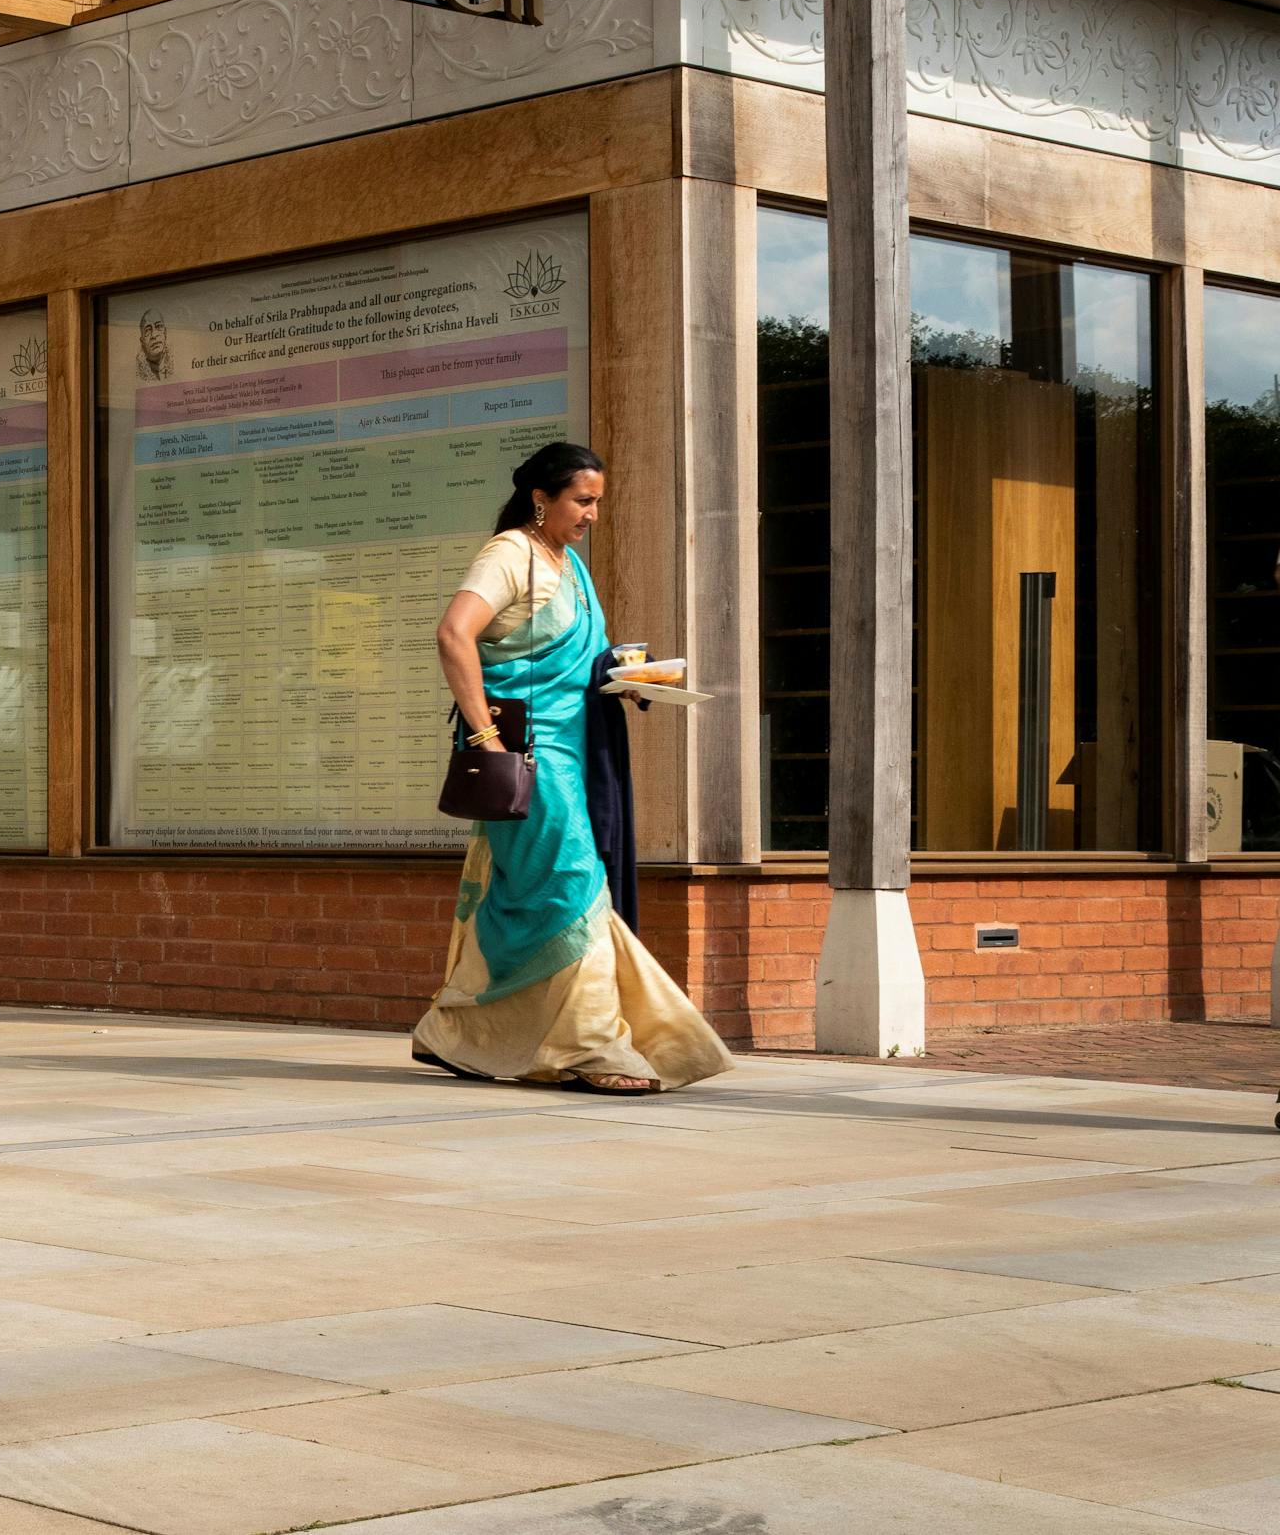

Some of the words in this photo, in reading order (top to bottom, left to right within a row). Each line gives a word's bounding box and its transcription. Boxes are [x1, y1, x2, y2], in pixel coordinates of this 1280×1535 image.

[209, 321, 223, 332] On
[225, 315, 253, 330] behalf
[255, 313, 265, 325] of
[267, 311, 288, 323] Srila
[290, 300, 347, 319] Prabhupada
[350, 297, 367, 309] and
[370, 294, 381, 306] all
[384, 293, 402, 304] our
[404, 281, 477, 301] congregations,
[510, 301, 560, 318] ISKCON
[225, 336, 243, 347] Our
[245, 328, 286, 344] Heartfelt
[288, 322, 333, 337] Gratitude
[336, 320, 345, 330] to
[348, 316, 363, 328] the
[365, 310, 411, 326] following
[414, 303, 459, 318] devotees,
[192, 358, 204, 369] for
[207, 354, 228, 367] their
[230, 349, 266, 364] sacrifice
[269, 346, 286, 358] and
[288, 340, 330, 359] generous
[332, 334, 369, 350] support
[372, 331, 386, 342] for
[389, 327, 404, 340] the
[406, 325, 420, 337] Sri
[423, 319, 463, 335] Krishna
[466, 313, 499, 328] Haveli
[381, 369, 397, 380] This
[399, 366, 425, 380] plaque
[426, 364, 440, 374] can
[442, 361, 452, 371] be
[454, 359, 474, 370] from
[475, 357, 495, 368] your
[496, 351, 523, 365] family
[484, 402, 508, 414] Rupen
[509, 398, 533, 408] Tanna
[0, 417, 8, 428] by
[358, 418, 374, 428] Ajay
[375, 416, 381, 425] &
[383, 414, 401, 424] Swati
[403, 410, 429, 422] Piramal
[171, 448, 177, 456] &
[124, 827, 155, 838] Temporary
[156, 827, 176, 838] display
[177, 827, 186, 836] for
[187, 827, 216, 836] donations
[217, 827, 235, 836] above
[268, 829, 280, 838] you
[281, 828, 302, 836] cannot
[304, 827, 318, 836] find
[318, 829, 333, 838] your
[334, 829, 354, 837] name,
[363, 828, 380, 836] want
[390, 827, 413, 838] change
[414, 827, 450, 838] something
[451, 827, 472, 838] please
[172, 840, 188, 848] have
[190, 840, 217, 848] donated
[218, 840, 246, 848] towards
[248, 840, 261, 848] the
[261, 840, 279, 848] brick
